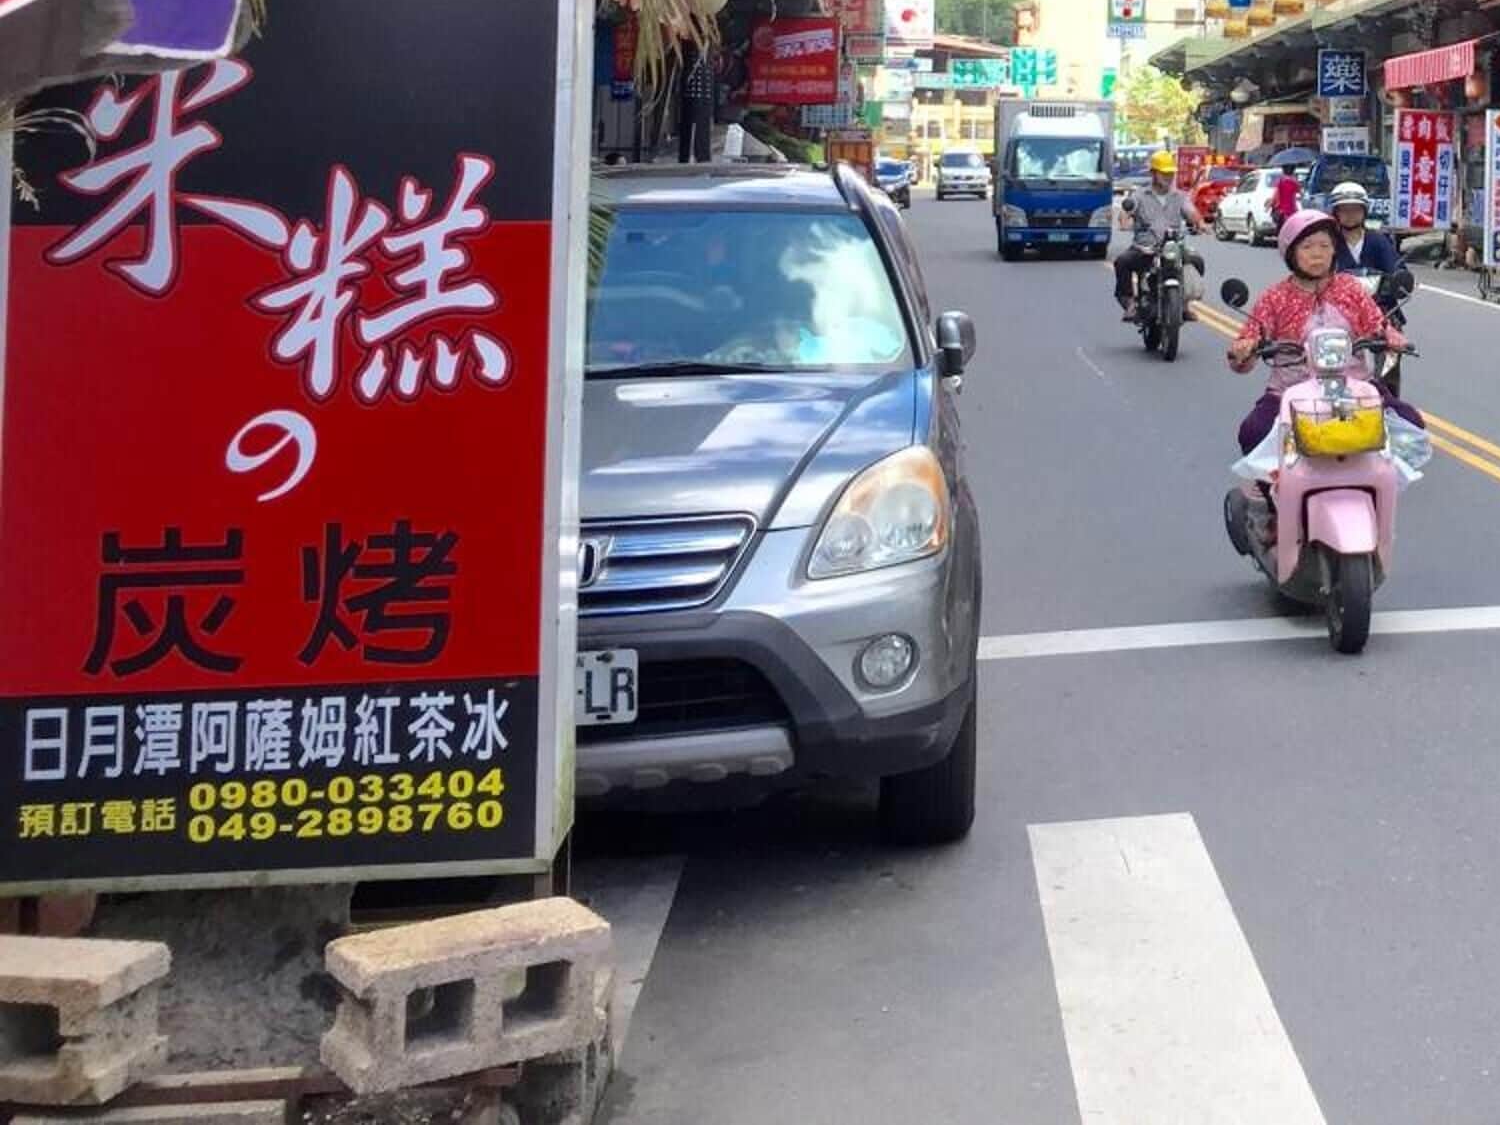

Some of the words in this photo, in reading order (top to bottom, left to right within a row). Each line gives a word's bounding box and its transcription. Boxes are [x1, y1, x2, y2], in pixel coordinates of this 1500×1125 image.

[1323, 55, 1361, 93] 藥
[225, 411, 319, 503] の
[83, 520, 458, 677] 炭烤
[24, 689, 510, 784] 日月潭阿薩姆紅茶冰
[18, 801, 177, 839] 預訂電話
[189, 768, 506, 811] 0980-033404
[188, 800, 505, 845] 049-2898760
